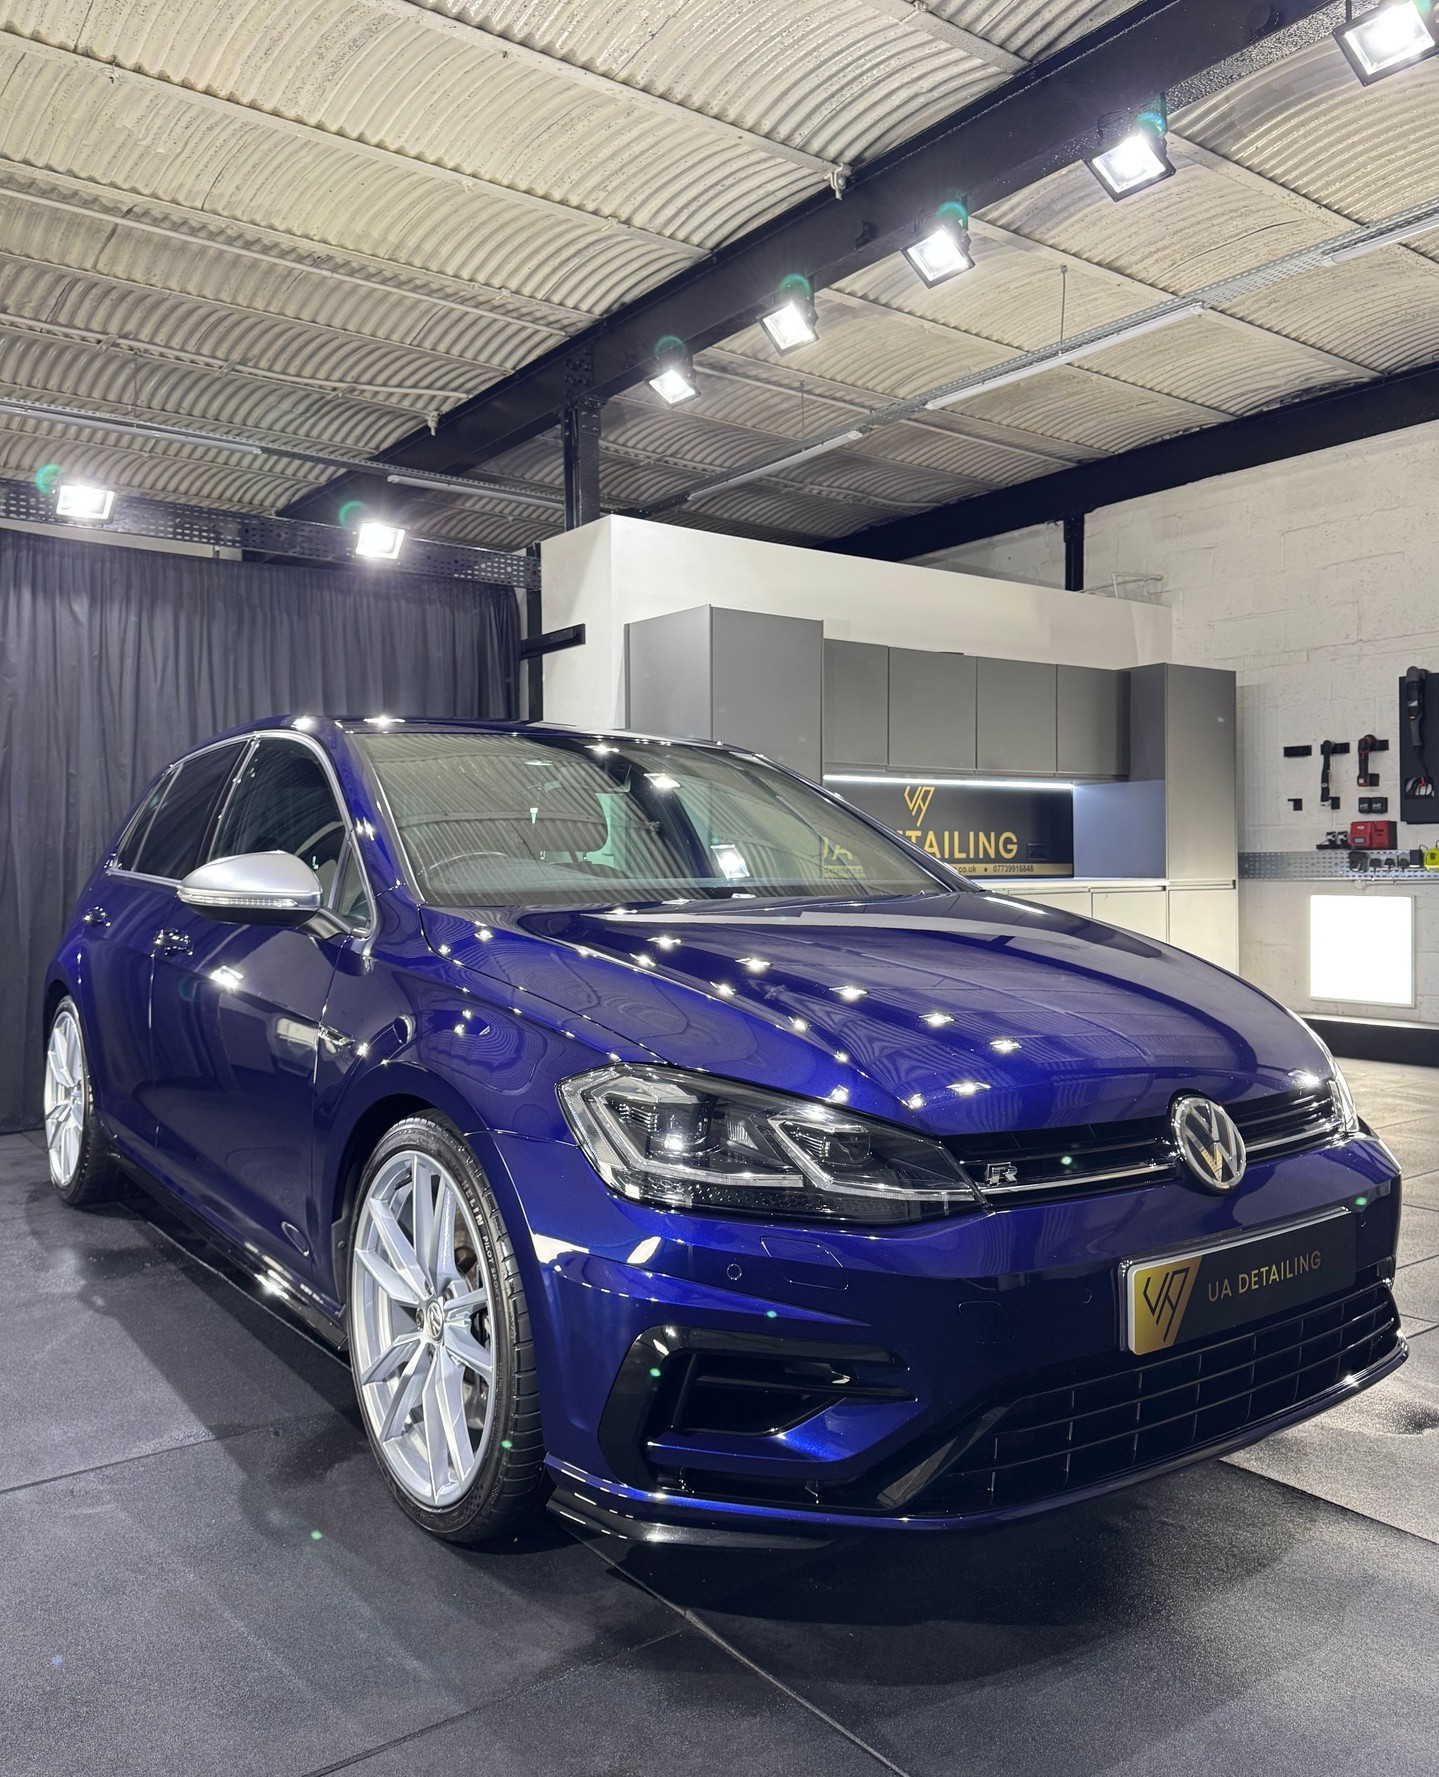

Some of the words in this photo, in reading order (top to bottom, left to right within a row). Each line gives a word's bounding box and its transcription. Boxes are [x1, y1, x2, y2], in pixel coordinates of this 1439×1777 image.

[897, 831, 1018, 859] TAILING
[482, 1235, 495, 1264] PILOT
[1208, 1280, 1232, 1302] UA
[1238, 1250, 1322, 1294] DETAILING
